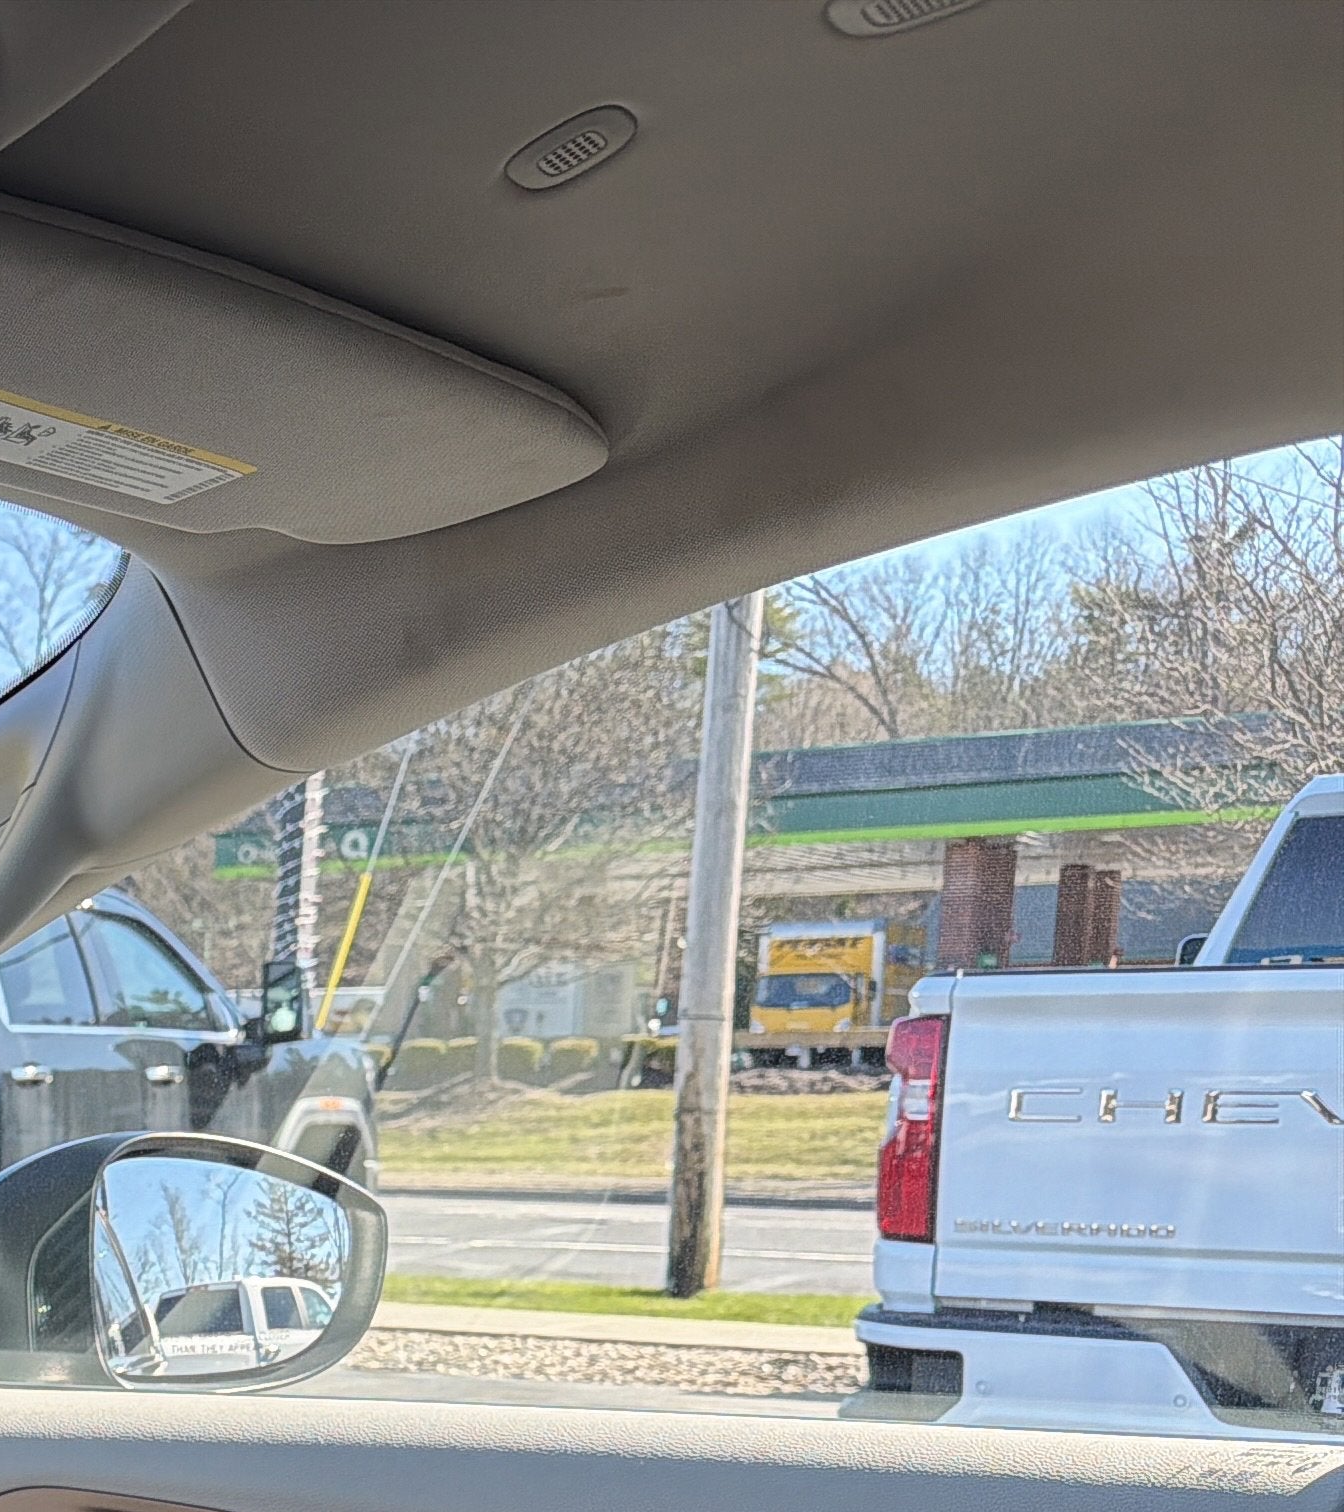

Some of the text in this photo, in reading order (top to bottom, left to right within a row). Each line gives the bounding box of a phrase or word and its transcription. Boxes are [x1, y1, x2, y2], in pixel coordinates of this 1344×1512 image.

[953, 1217, 1176, 1239] SILVERADO
[171, 1344, 196, 1353] THAN
[200, 1344, 224, 1353] THEY
